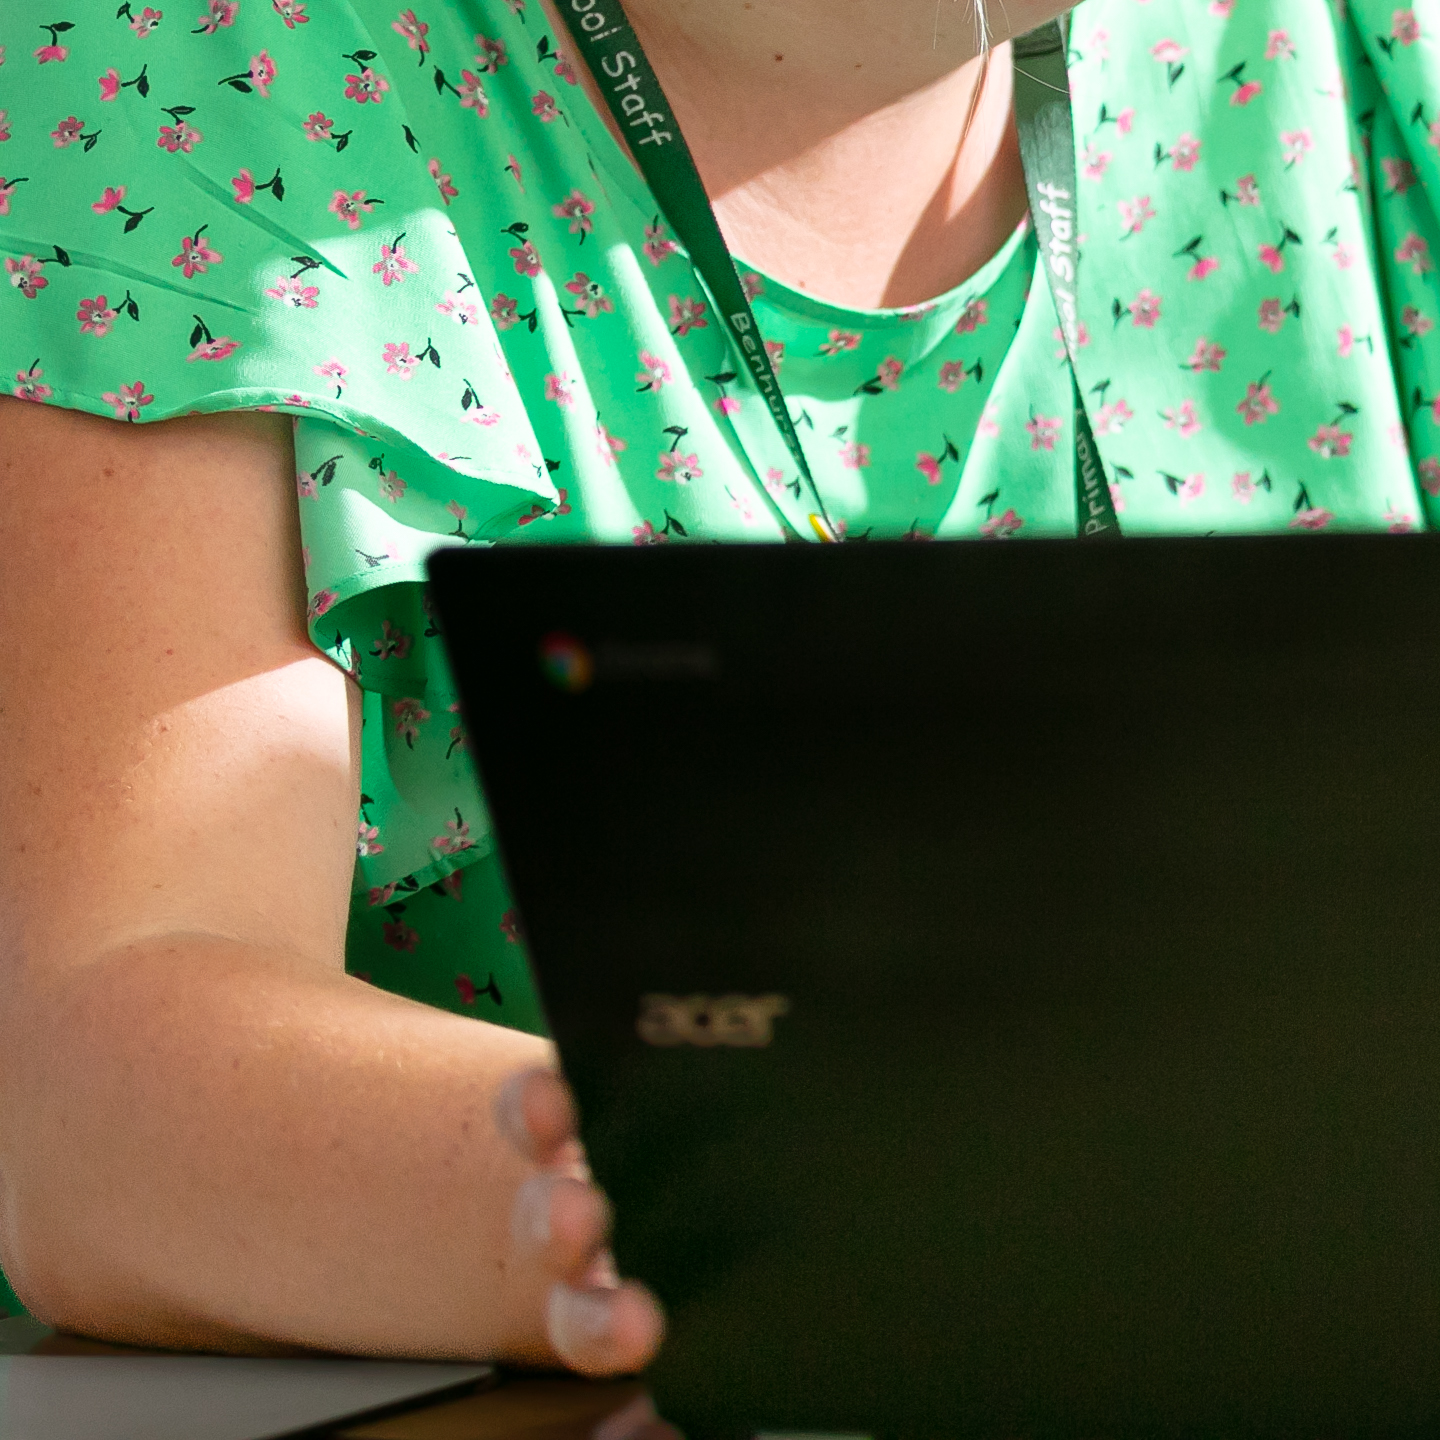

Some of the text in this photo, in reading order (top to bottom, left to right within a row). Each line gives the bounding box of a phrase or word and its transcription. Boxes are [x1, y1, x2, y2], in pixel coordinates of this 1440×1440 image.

[602, 50, 672, 146] Staff
[1037, 181, 1075, 283] Staff
[730, 312, 801, 461] Benhur
